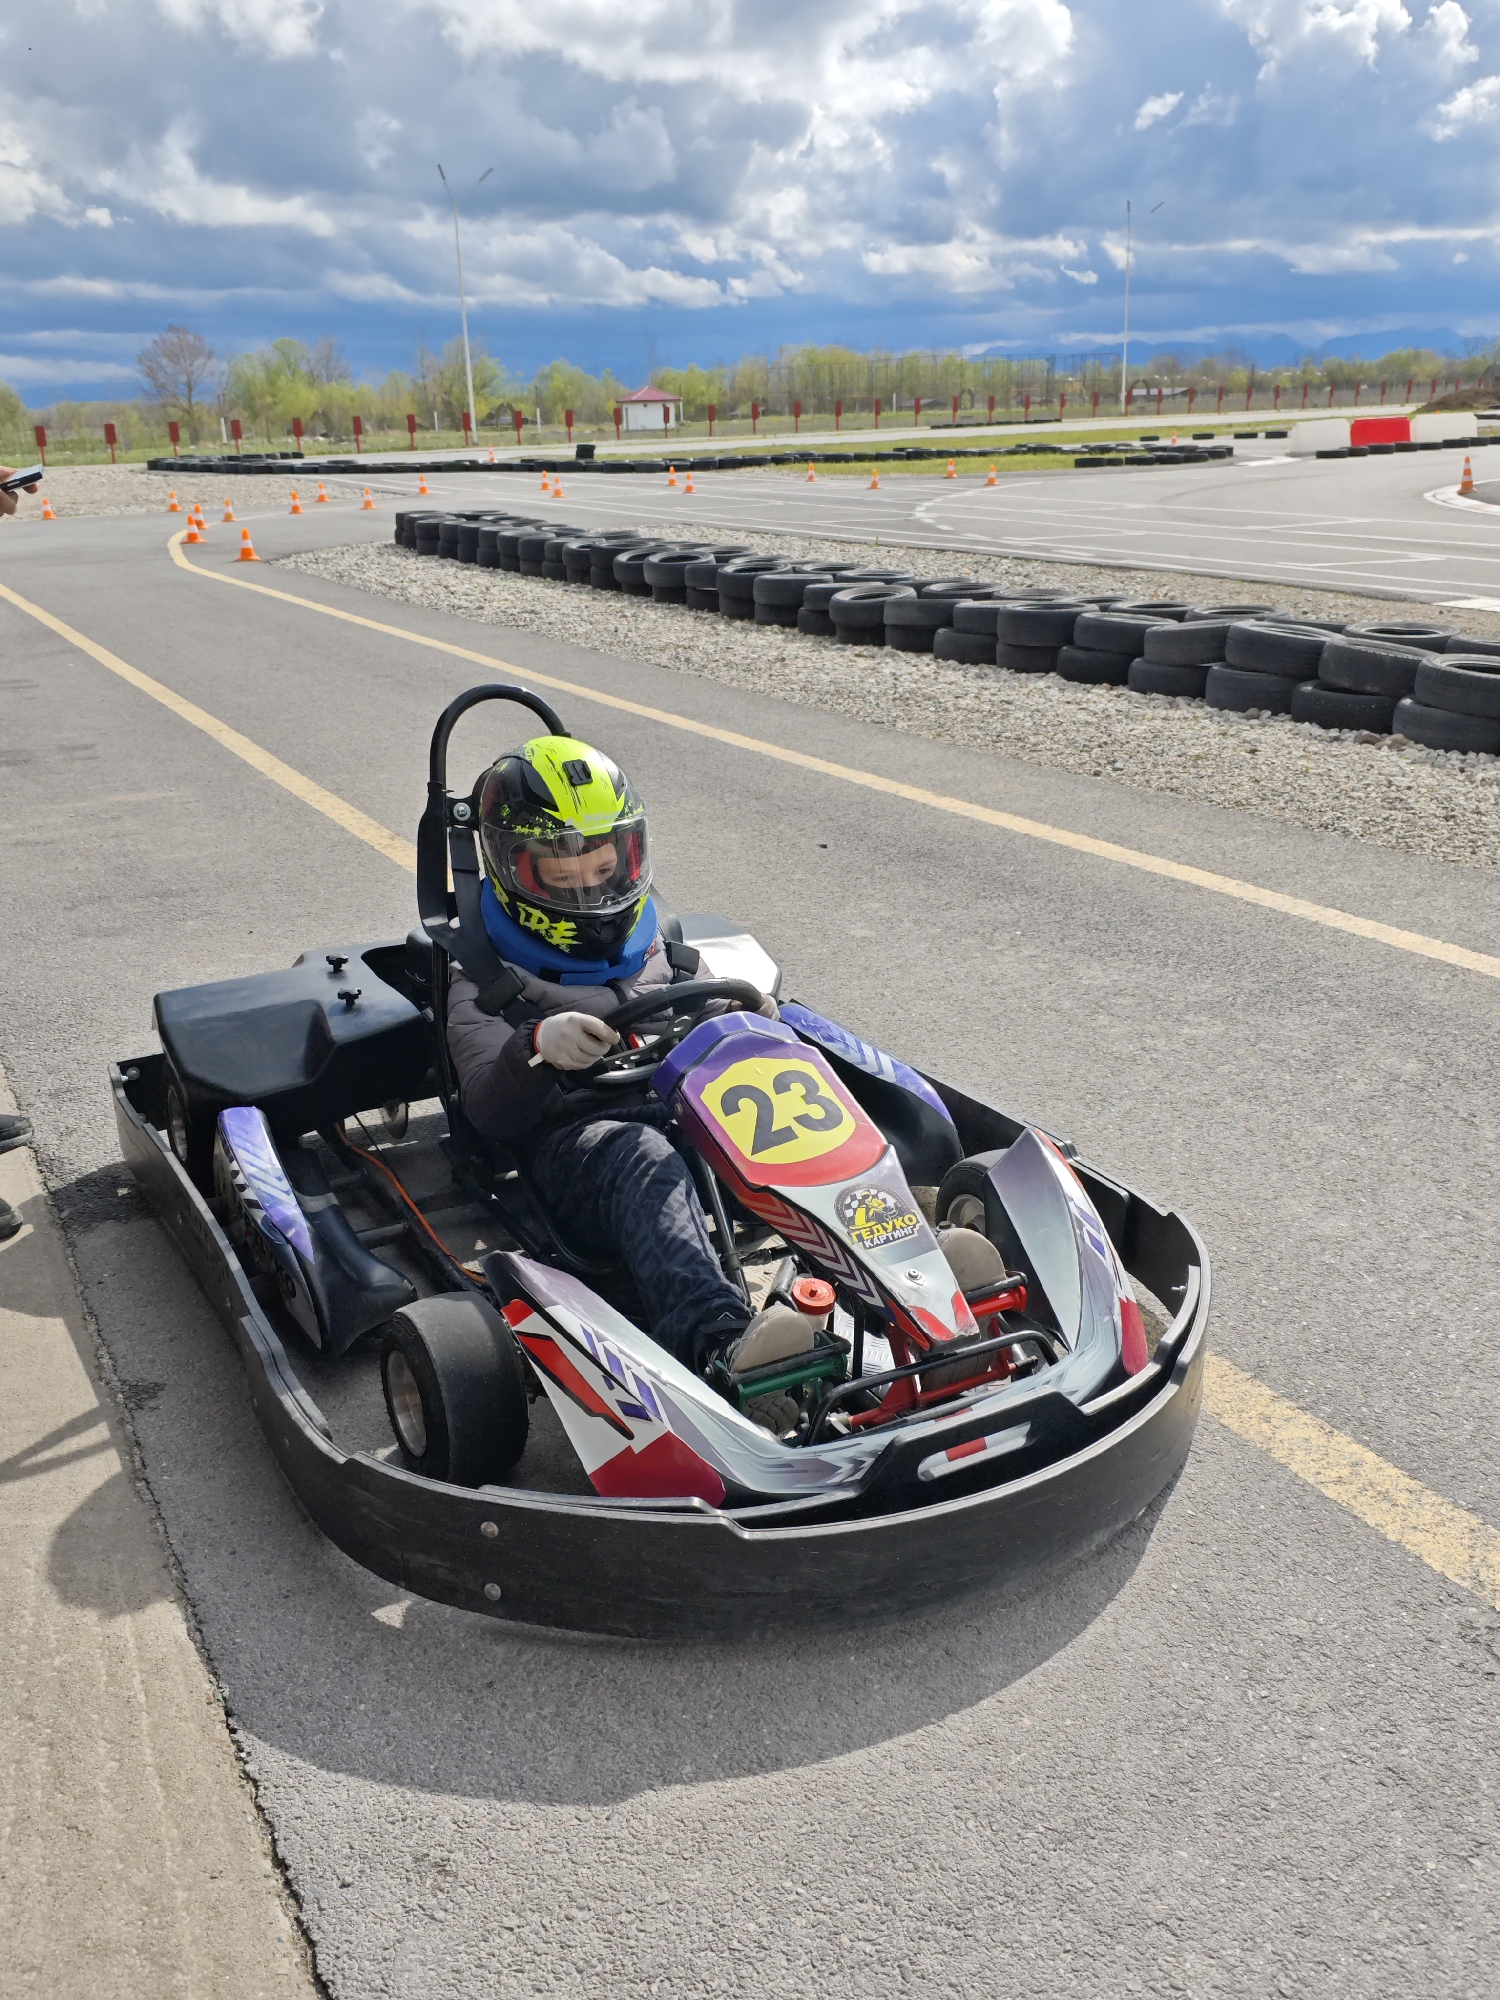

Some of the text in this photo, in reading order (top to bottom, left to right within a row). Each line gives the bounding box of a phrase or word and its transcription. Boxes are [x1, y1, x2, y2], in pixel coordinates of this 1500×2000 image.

[720, 1069, 844, 1156] 23
[850, 1213, 917, 1243] ГЕДУКО
[863, 1225, 914, 1248] КАРТИНГ
